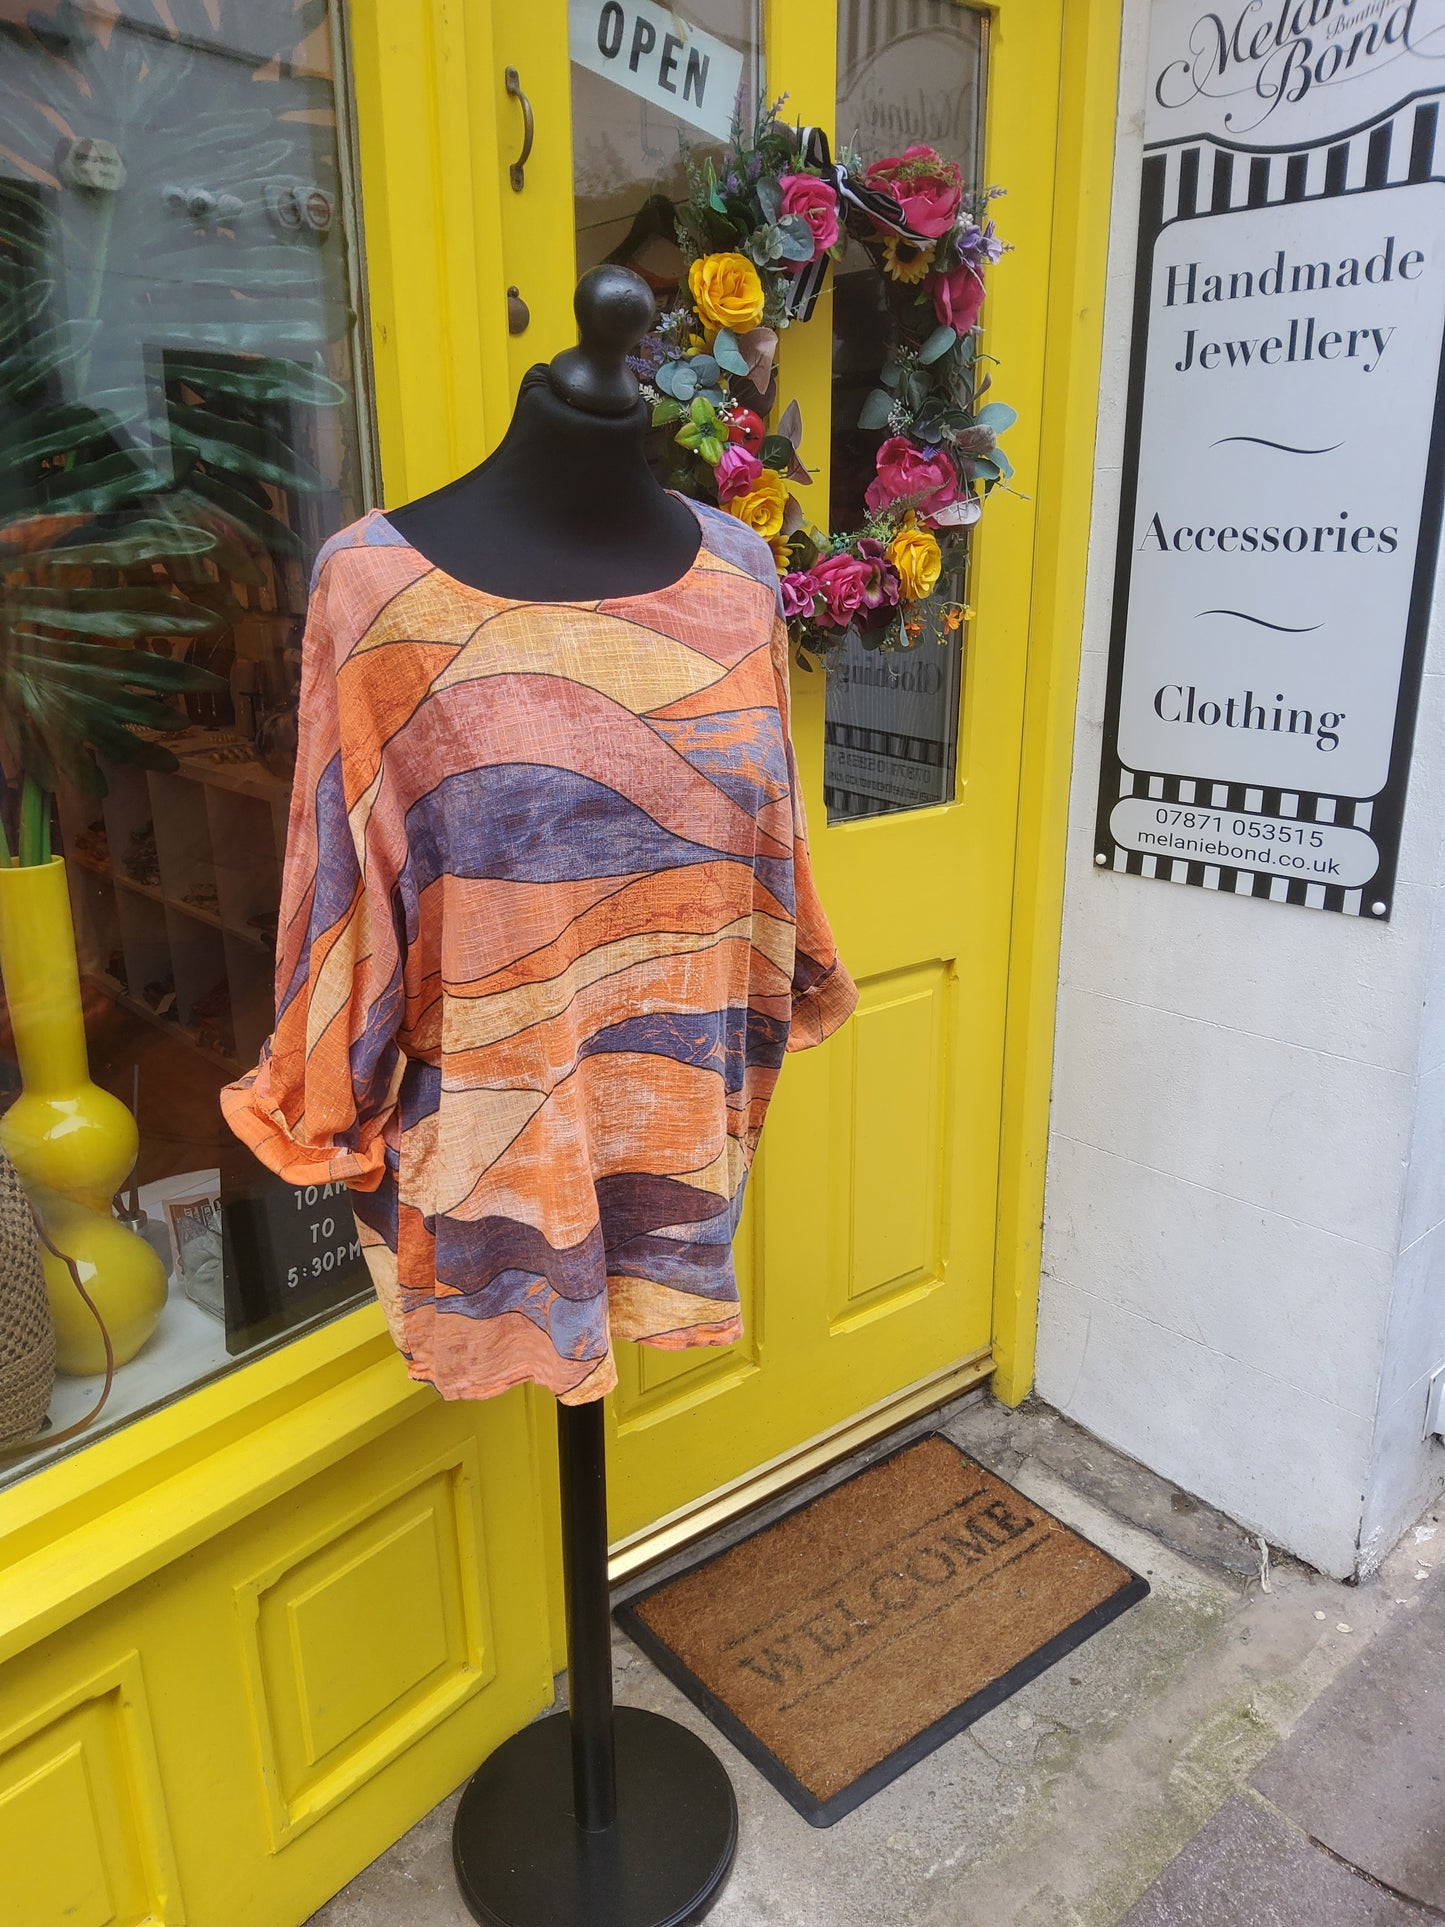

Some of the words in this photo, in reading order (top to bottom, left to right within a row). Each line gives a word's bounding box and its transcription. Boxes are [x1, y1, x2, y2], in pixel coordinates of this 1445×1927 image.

[598, 0, 710, 109] OPEN
[1162, 236, 1424, 307] Handmade
[1175, 317, 1397, 373] Jewellery
[1136, 511, 1399, 554] Accessories
[1153, 684, 1346, 752] Clothing
[1138, 831, 1341, 876] melaniebond.co.uk
[1155, 808, 1222, 833] 07871
[1231, 819, 1324, 848] 053515
[310, 1218, 335, 1243] TO
[287, 1238, 361, 1288] 5:30PM
[738, 1500, 1035, 1687] WELCOME
